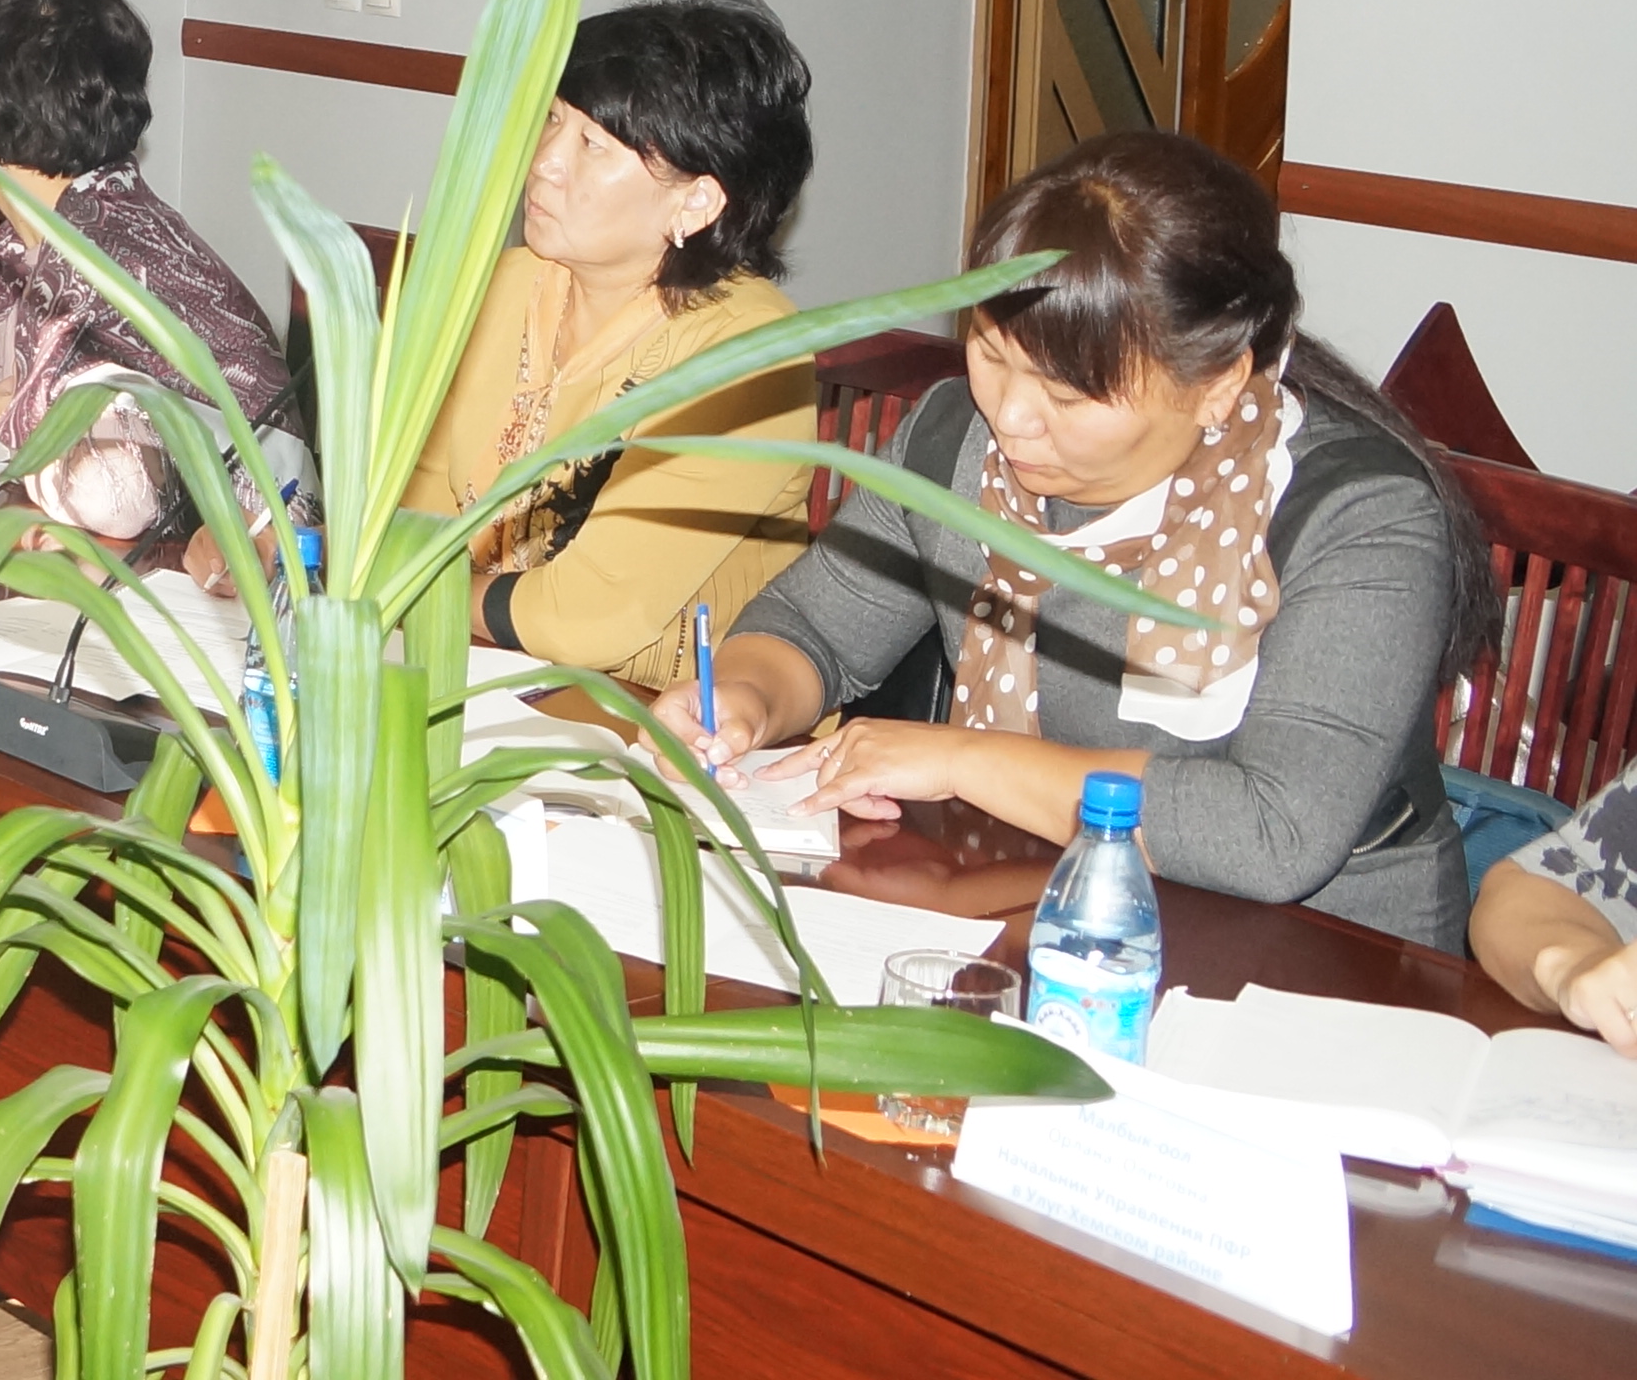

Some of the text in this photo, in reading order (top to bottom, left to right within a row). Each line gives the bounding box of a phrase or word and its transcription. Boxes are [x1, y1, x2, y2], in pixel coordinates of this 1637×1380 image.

[998, 1146, 1251, 1260] Начальник Управления ПФР
